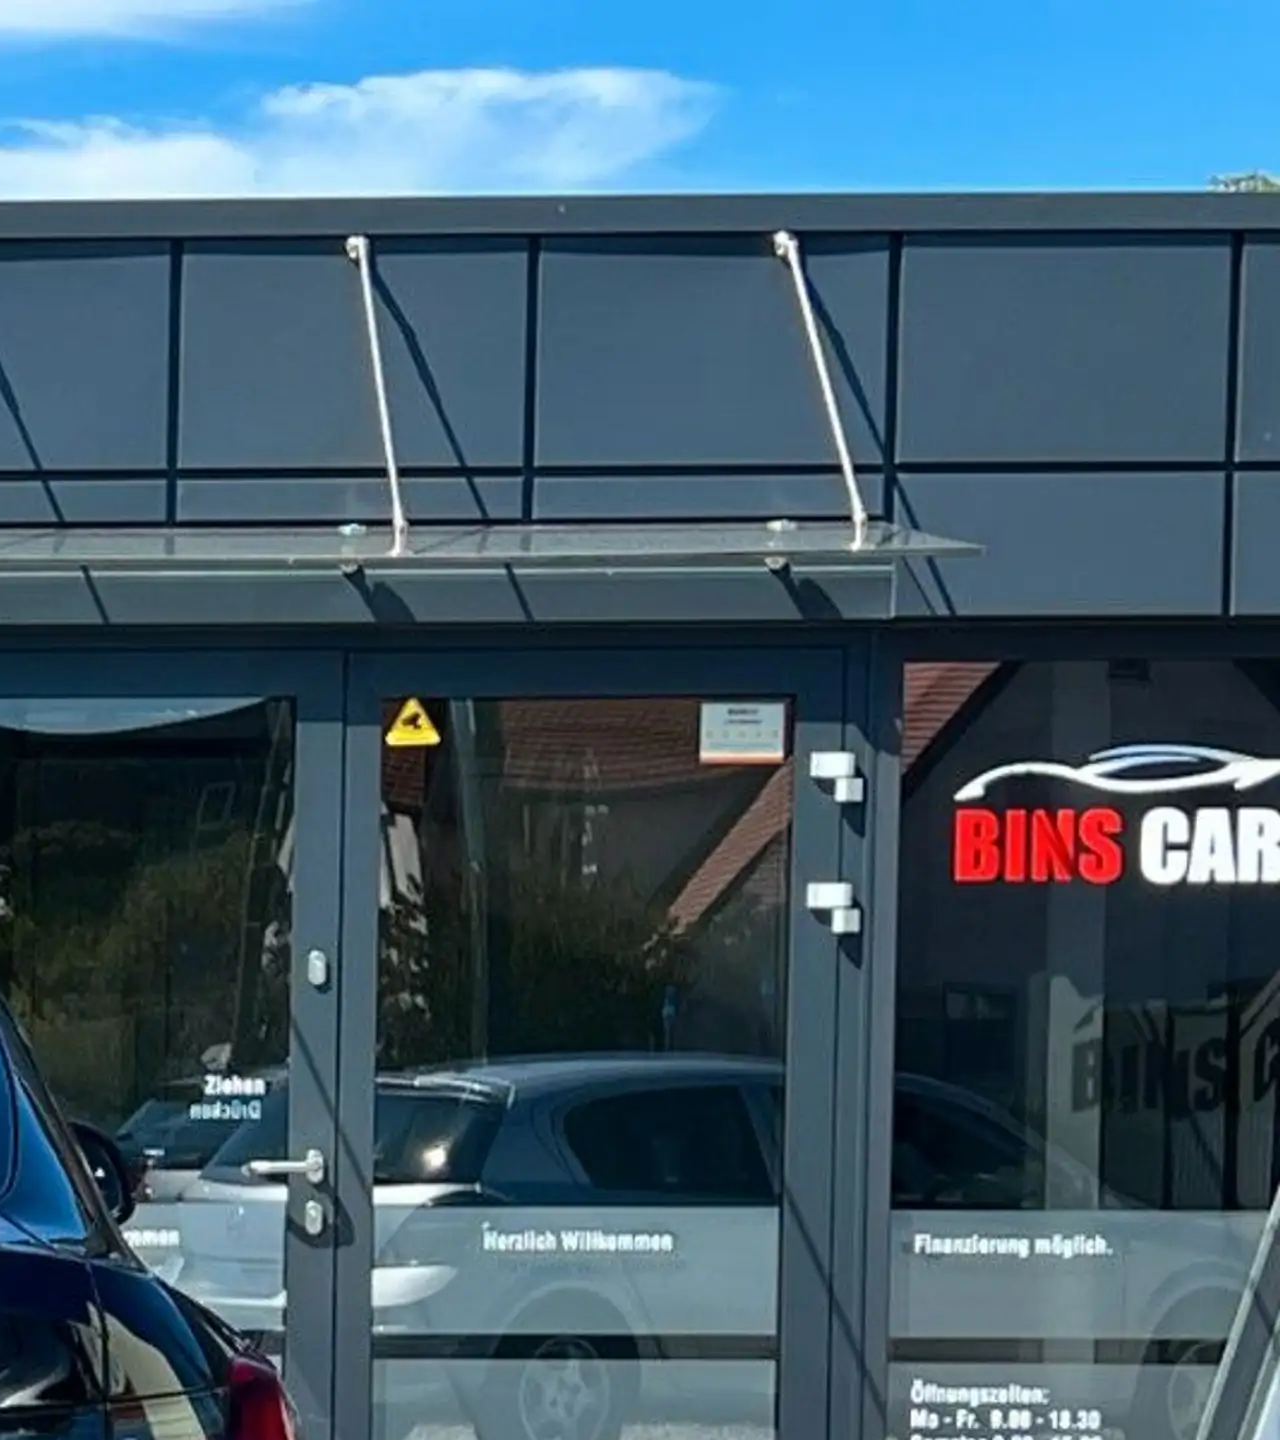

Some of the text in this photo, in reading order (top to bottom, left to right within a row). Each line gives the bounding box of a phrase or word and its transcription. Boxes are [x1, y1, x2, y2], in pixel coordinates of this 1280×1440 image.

[954, 807, 1124, 885] BINS
[914, 1234, 1114, 1259] Finanzierung möglich.
[910, 1379, 1050, 1407] Öffnungszeiten:
